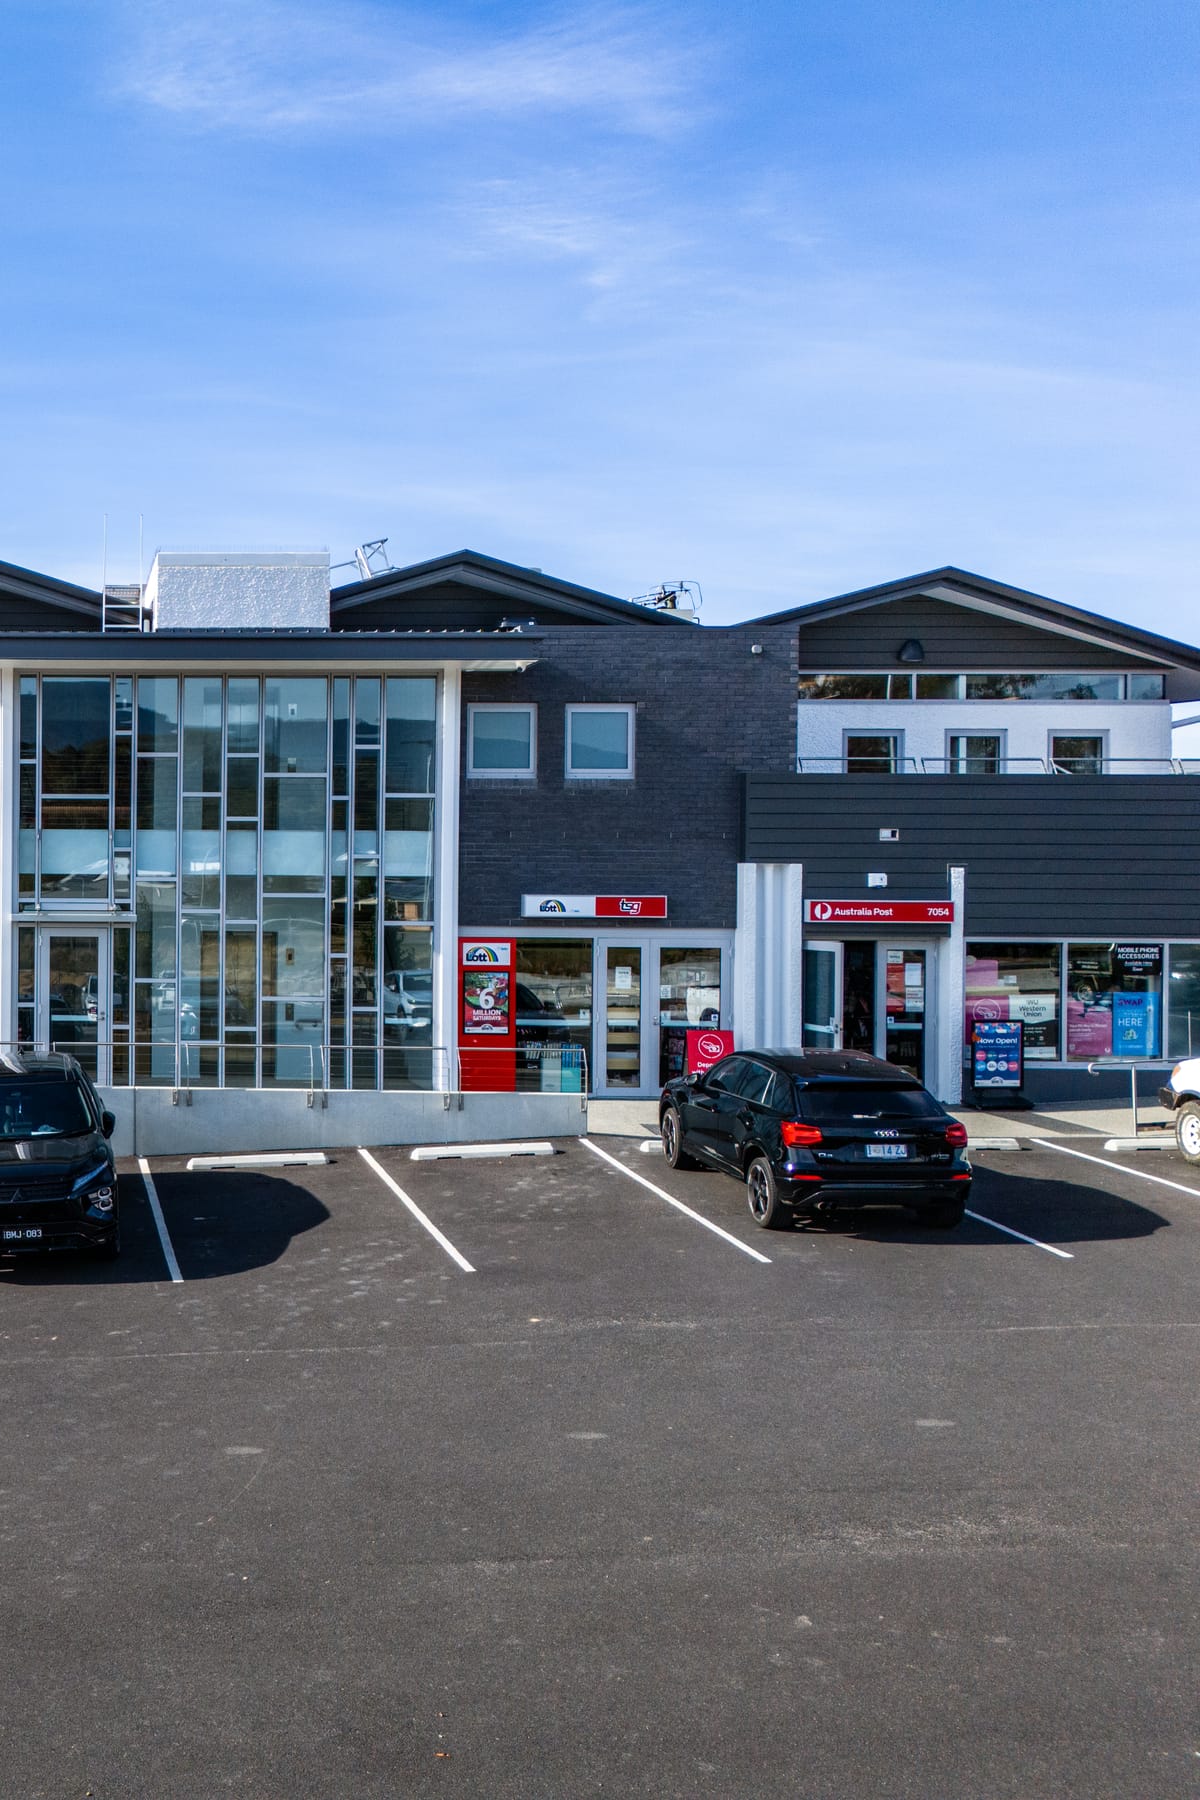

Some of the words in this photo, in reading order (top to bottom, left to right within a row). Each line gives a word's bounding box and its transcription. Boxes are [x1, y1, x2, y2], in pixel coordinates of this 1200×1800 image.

[619, 898, 641, 915] tsg
[834, 907, 872, 916] Australia
[873, 907, 893, 916] Post
[927, 908, 949, 916] 7054
[480, 988, 494, 1010] 6
[1118, 1018, 1143, 1026] HERE
